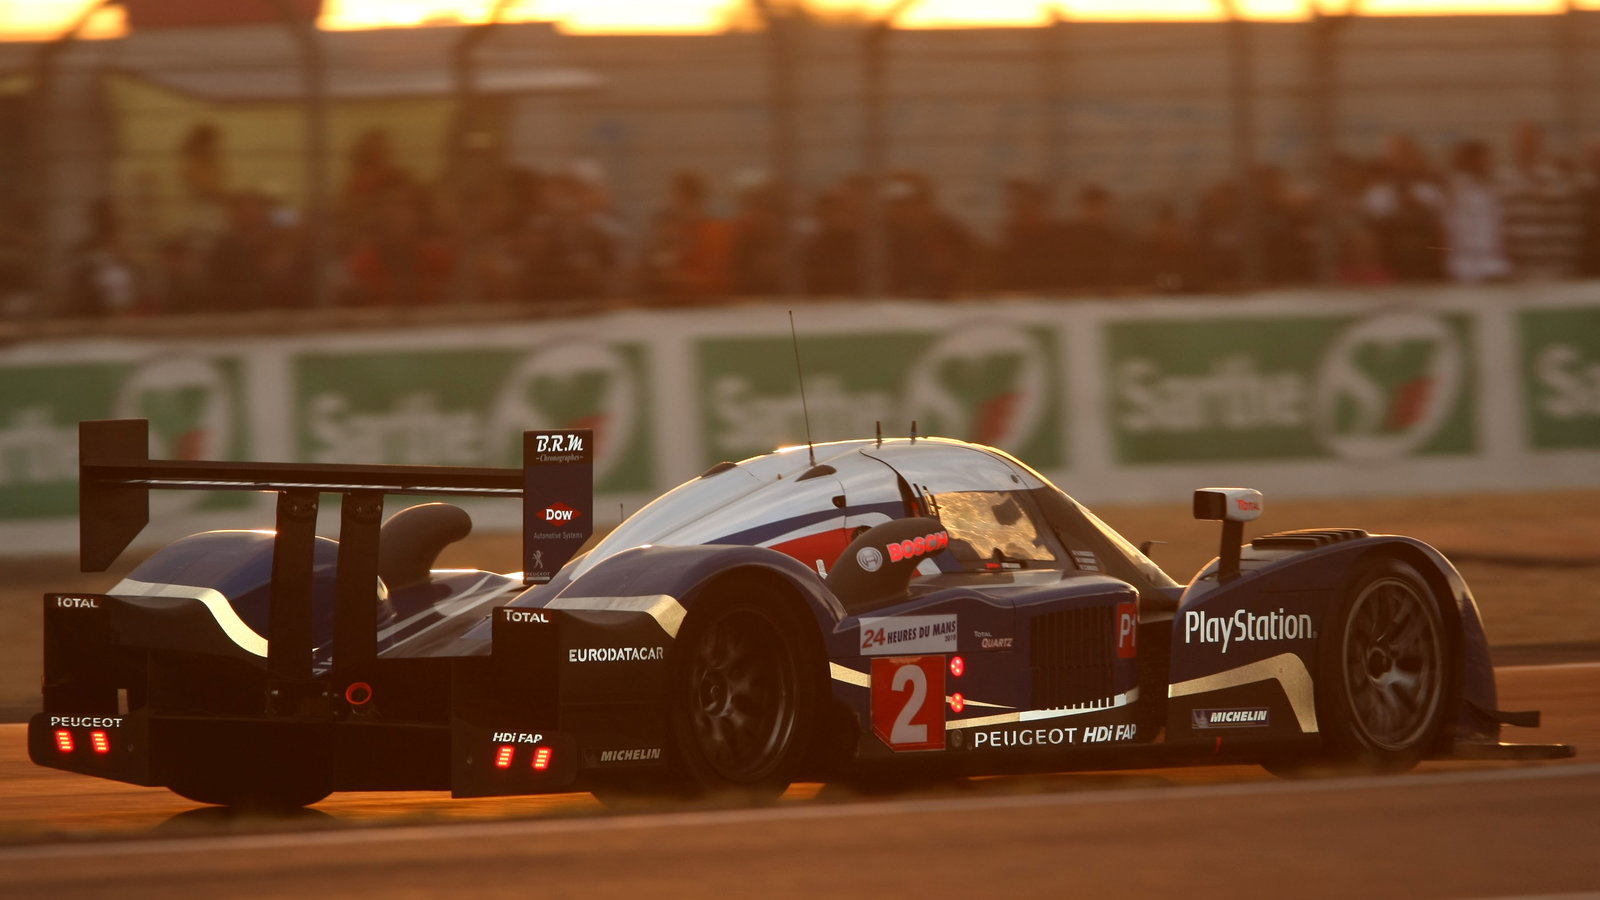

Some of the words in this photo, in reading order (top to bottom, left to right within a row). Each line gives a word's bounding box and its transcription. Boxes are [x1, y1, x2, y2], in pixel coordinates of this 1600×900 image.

[1118, 357, 1308, 434] Sarthe
[535, 434, 584, 452] B.R.M
[886, 531, 949, 562] BOSCH
[56, 595, 99, 608] TOTAL
[503, 609, 549, 623] TOTAL
[862, 628, 886, 648] 24
[887, 629, 917, 644] HEURES
[919, 624, 930, 639] DU
[932, 620, 956, 636] MANS
[973, 630, 992, 638] TOTAL
[1119, 613, 1136, 648] P1
[1185, 608, 1312, 653] PlayStation
[981, 638, 1013, 648] QUARTZ
[569, 647, 664, 662] EURODATACAR
[889, 664, 928, 744] 2
[50, 716, 123, 728] PEUGEOT
[1210, 710, 1268, 723] MICHELIN
[492, 732, 517, 742] HDi
[518, 733, 543, 743] FAP
[974, 727, 1078, 748] PEUGEOT
[1082, 725, 1113, 743] HDi
[1115, 723, 1137, 741] FAP
[600, 748, 661, 761] MICHELIN
